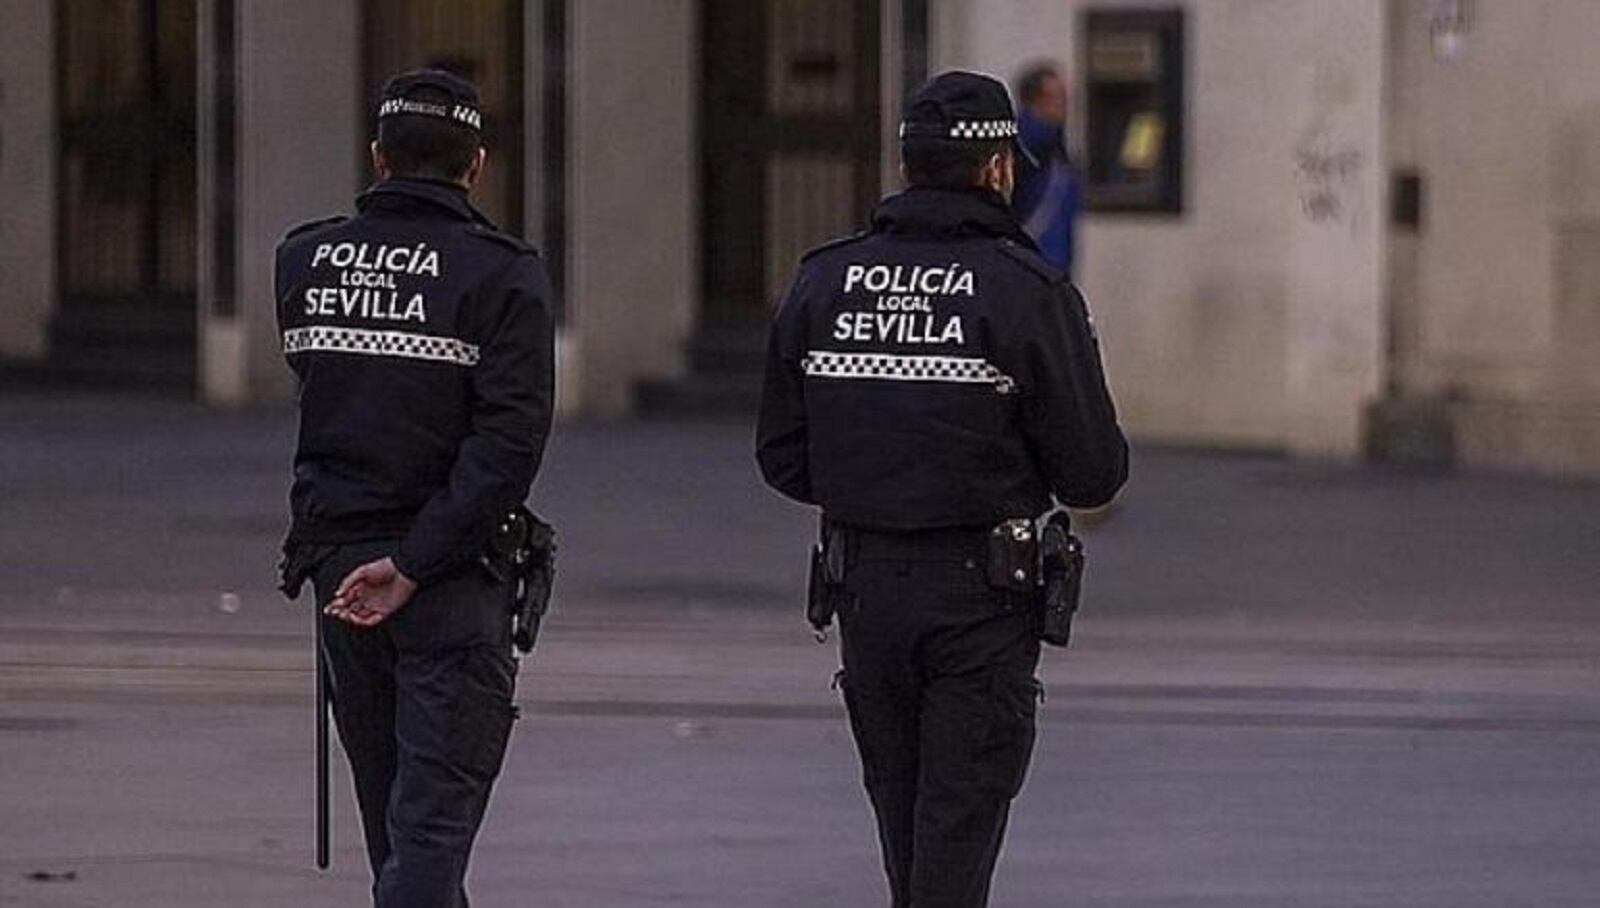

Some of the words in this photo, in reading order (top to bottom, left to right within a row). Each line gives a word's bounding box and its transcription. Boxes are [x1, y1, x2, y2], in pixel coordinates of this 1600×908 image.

[311, 242, 440, 277] POLICÍA
[340, 270, 397, 289] LOCAL
[843, 263, 974, 296] POLICÍA
[305, 287, 426, 323] SEVILLA
[876, 296, 932, 313] LOCAL
[833, 312, 964, 344] SEVILLA
